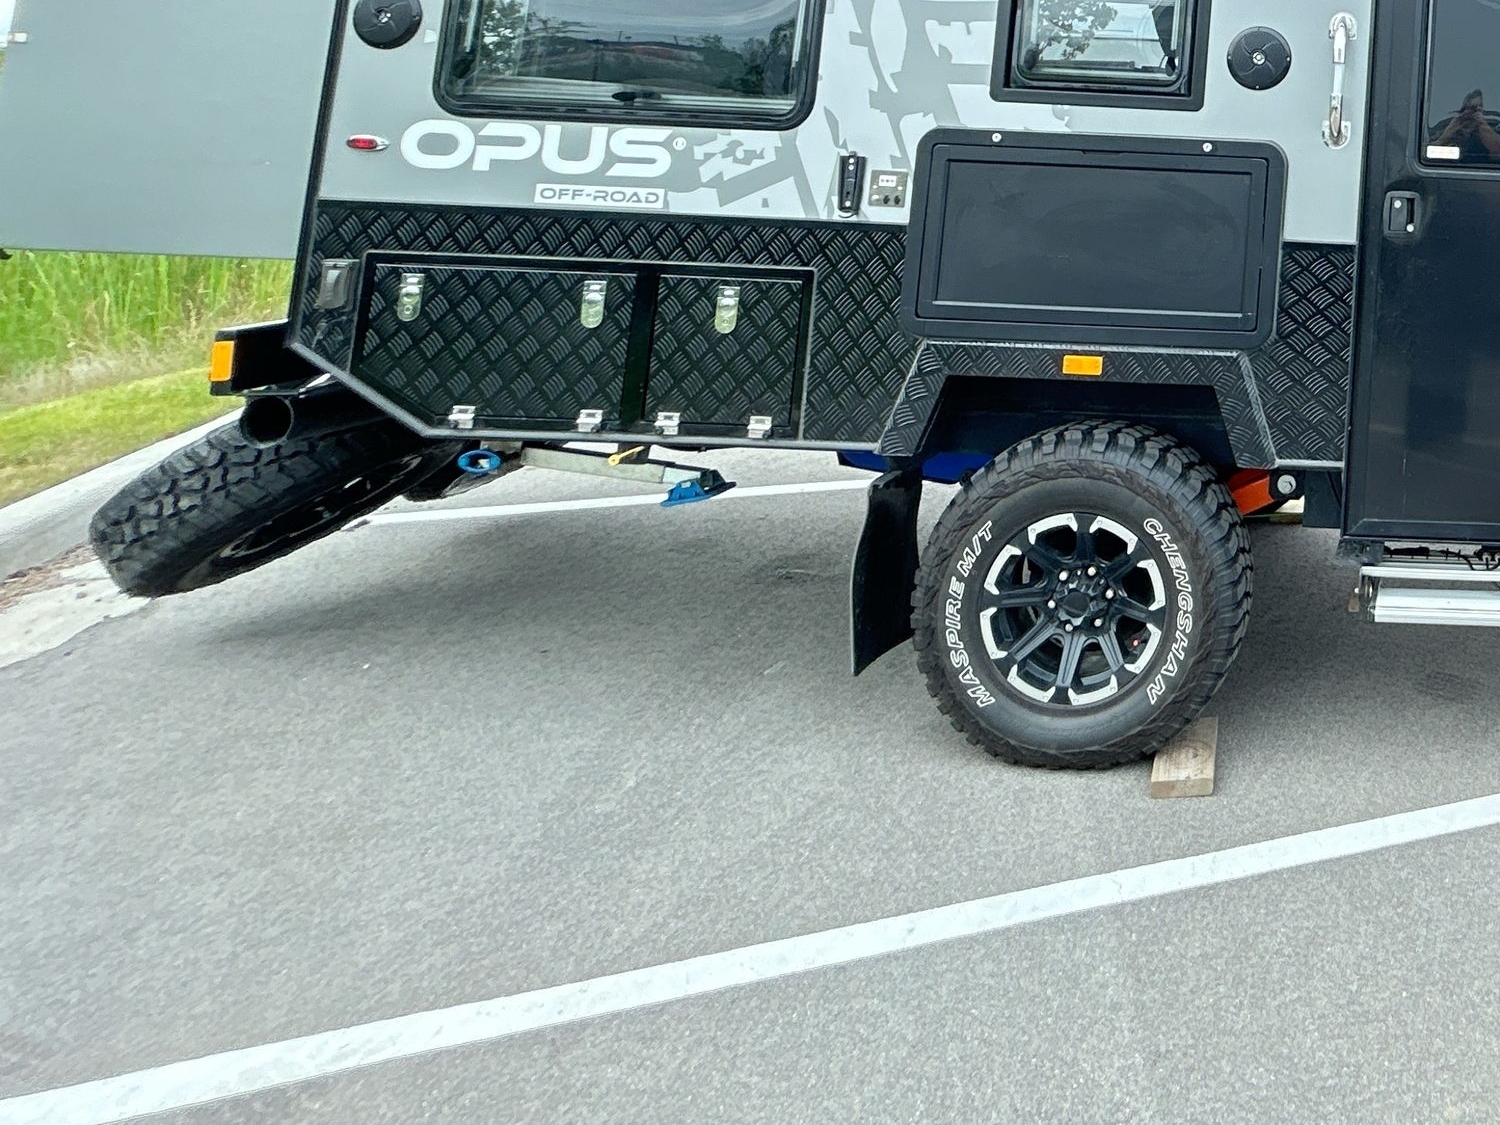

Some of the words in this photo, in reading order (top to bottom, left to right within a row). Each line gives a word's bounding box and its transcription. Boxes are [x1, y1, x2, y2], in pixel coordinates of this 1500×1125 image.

[539, 187, 660, 204] OFF-ROAD
[956, 520, 993, 578] M/T
[945, 575, 997, 708] MASPIRE
[1143, 517, 1194, 705] CHENGSHAN
